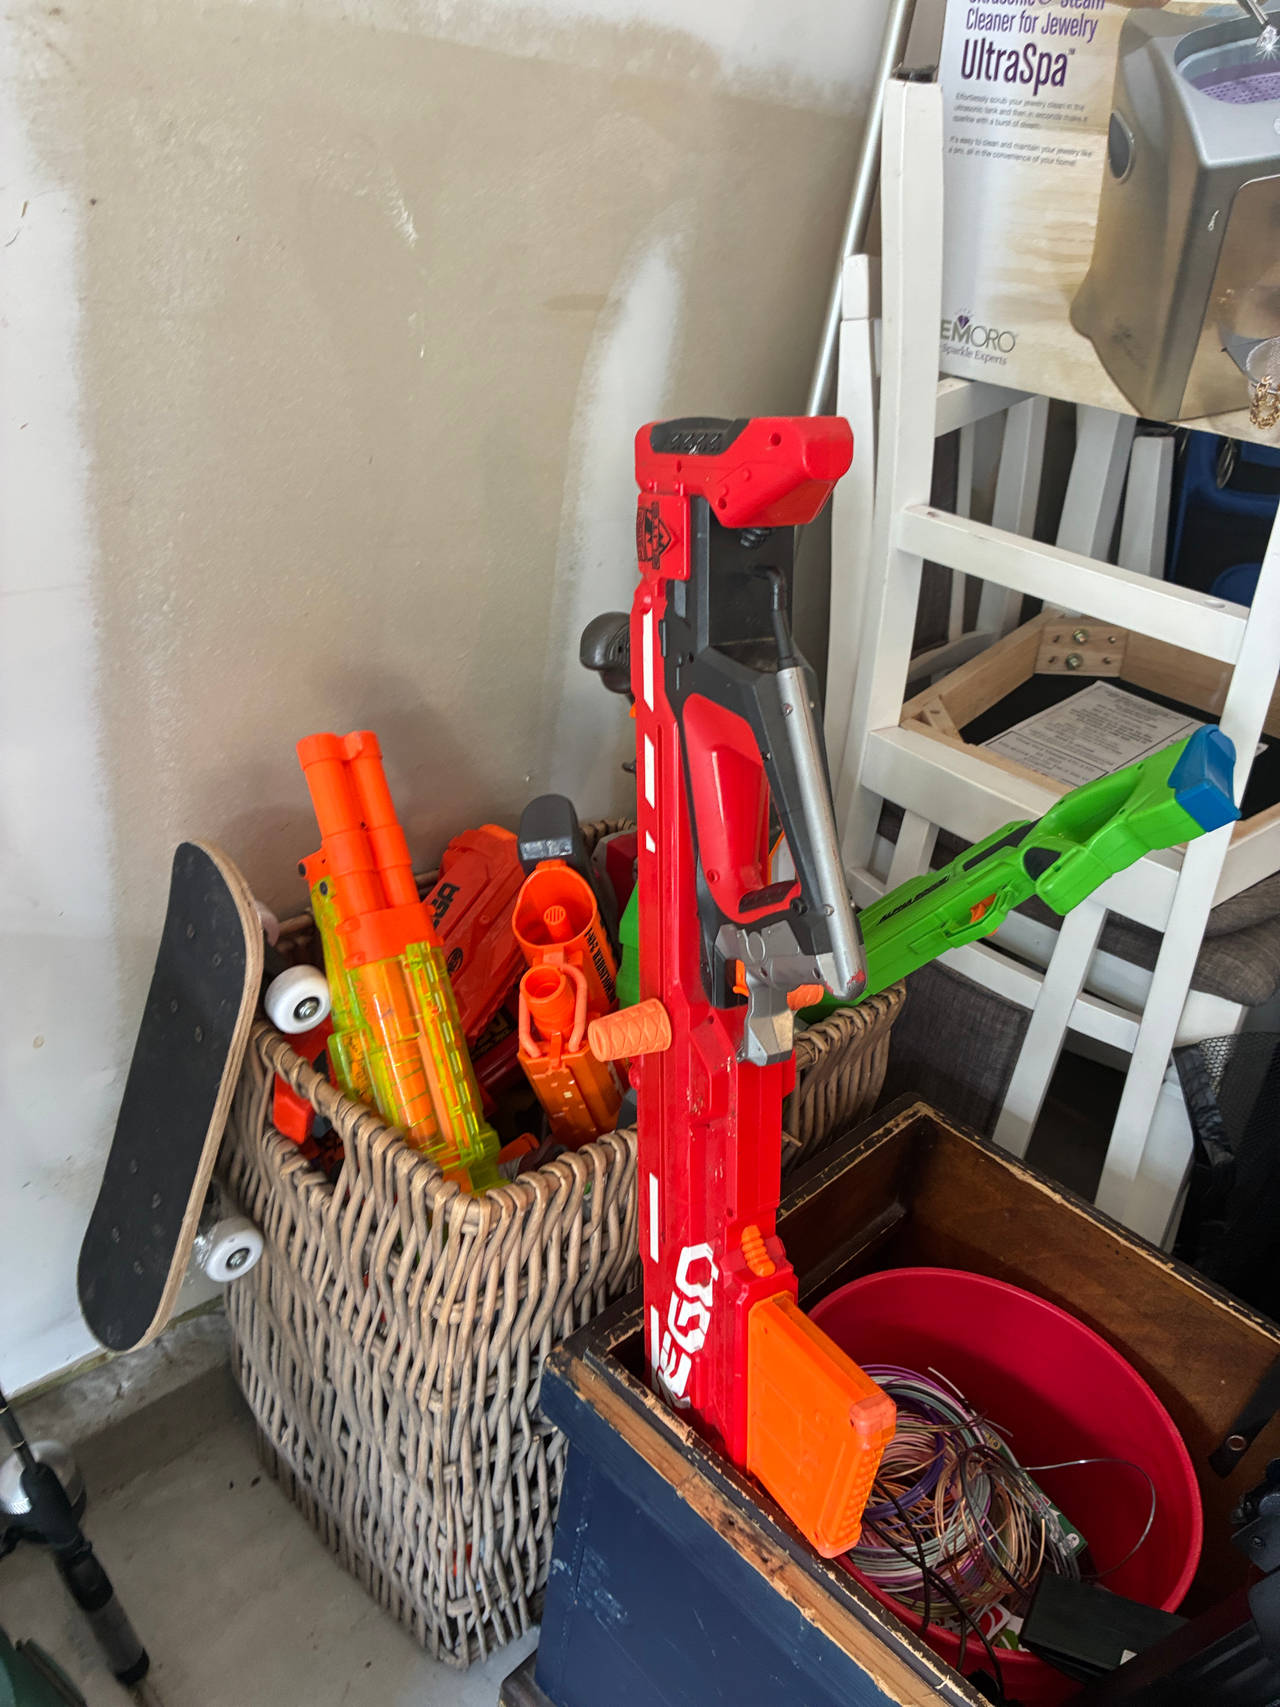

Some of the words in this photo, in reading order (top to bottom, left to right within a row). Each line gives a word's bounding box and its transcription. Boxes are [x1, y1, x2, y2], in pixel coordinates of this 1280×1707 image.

[966, 7, 1017, 32] Cleaner
[1018, 10, 1039, 34] for
[1041, 13, 1099, 43] Jewelry
[941, 318, 1016, 353] EMORO
